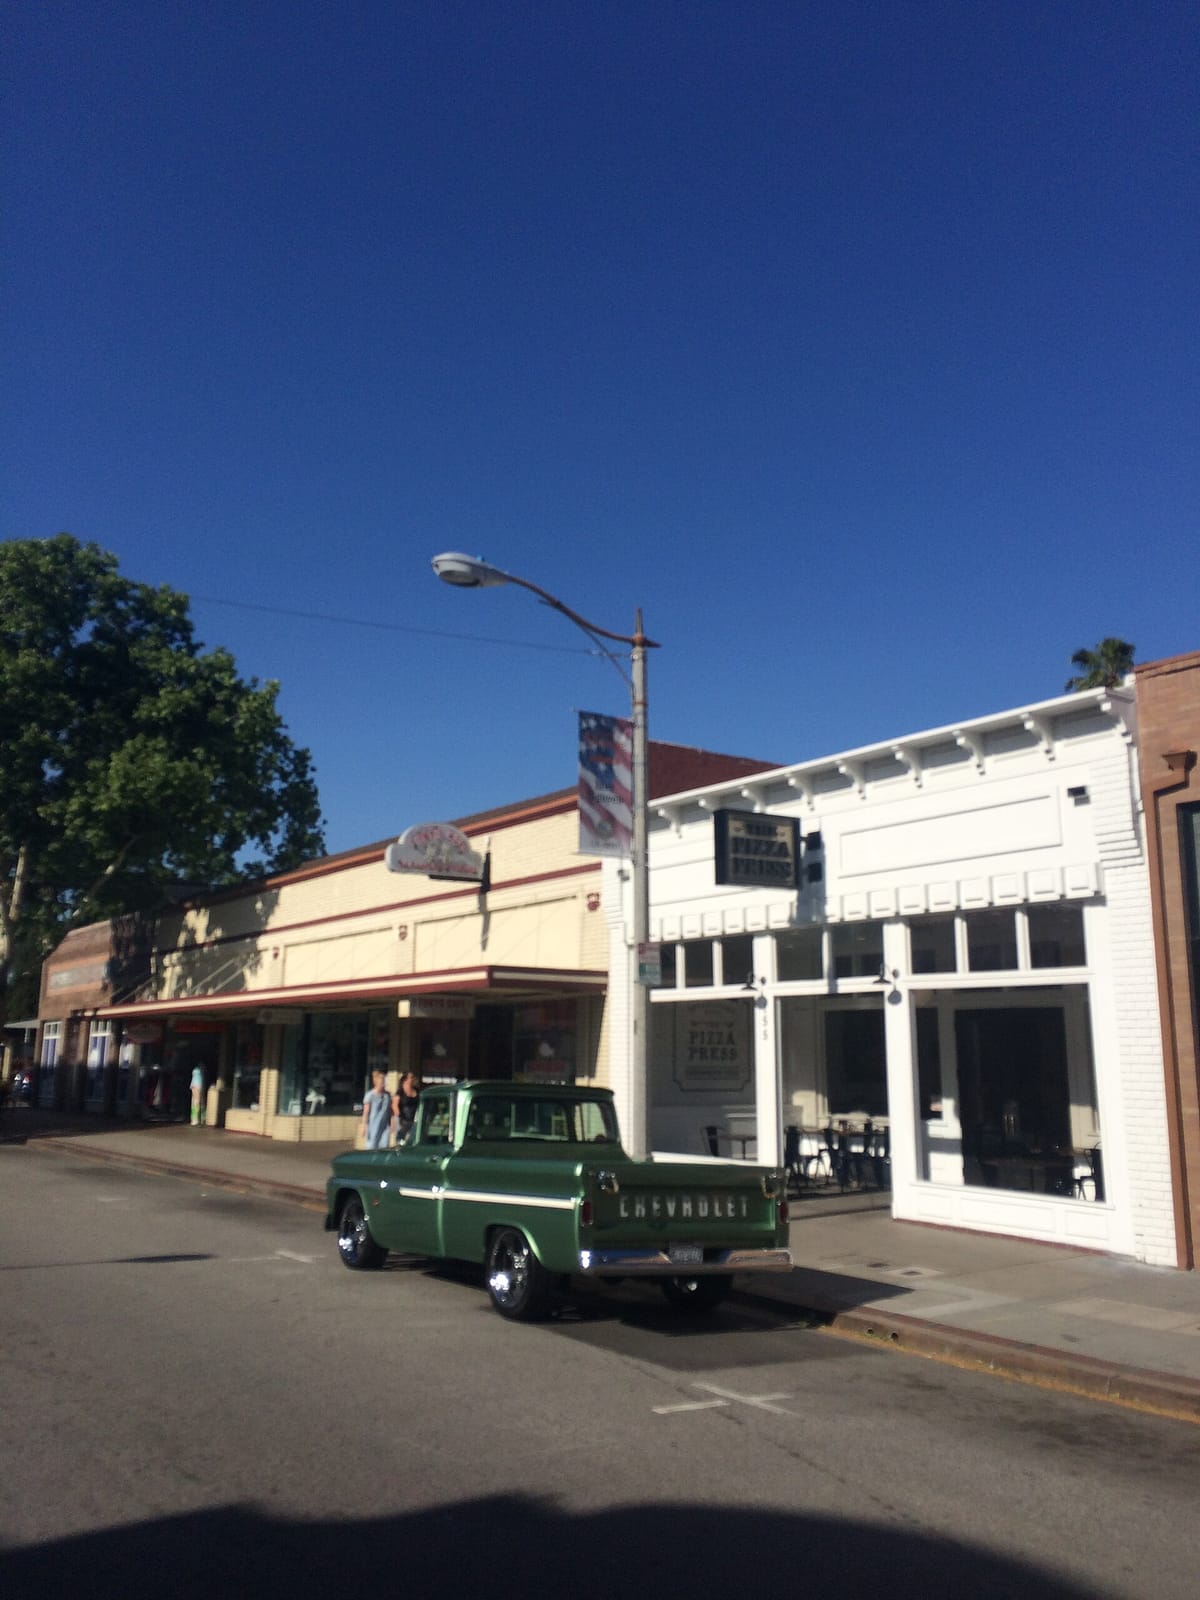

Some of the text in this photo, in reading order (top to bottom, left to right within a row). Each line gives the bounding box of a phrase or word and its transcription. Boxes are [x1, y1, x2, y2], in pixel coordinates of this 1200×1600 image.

[731, 836, 791, 858] PIZZA
[731, 857, 792, 880] PRESS
[688, 1031, 736, 1046] PIZZA
[688, 1046, 738, 1061] PRESS
[619, 1193, 749, 1218] CHEVROLET
